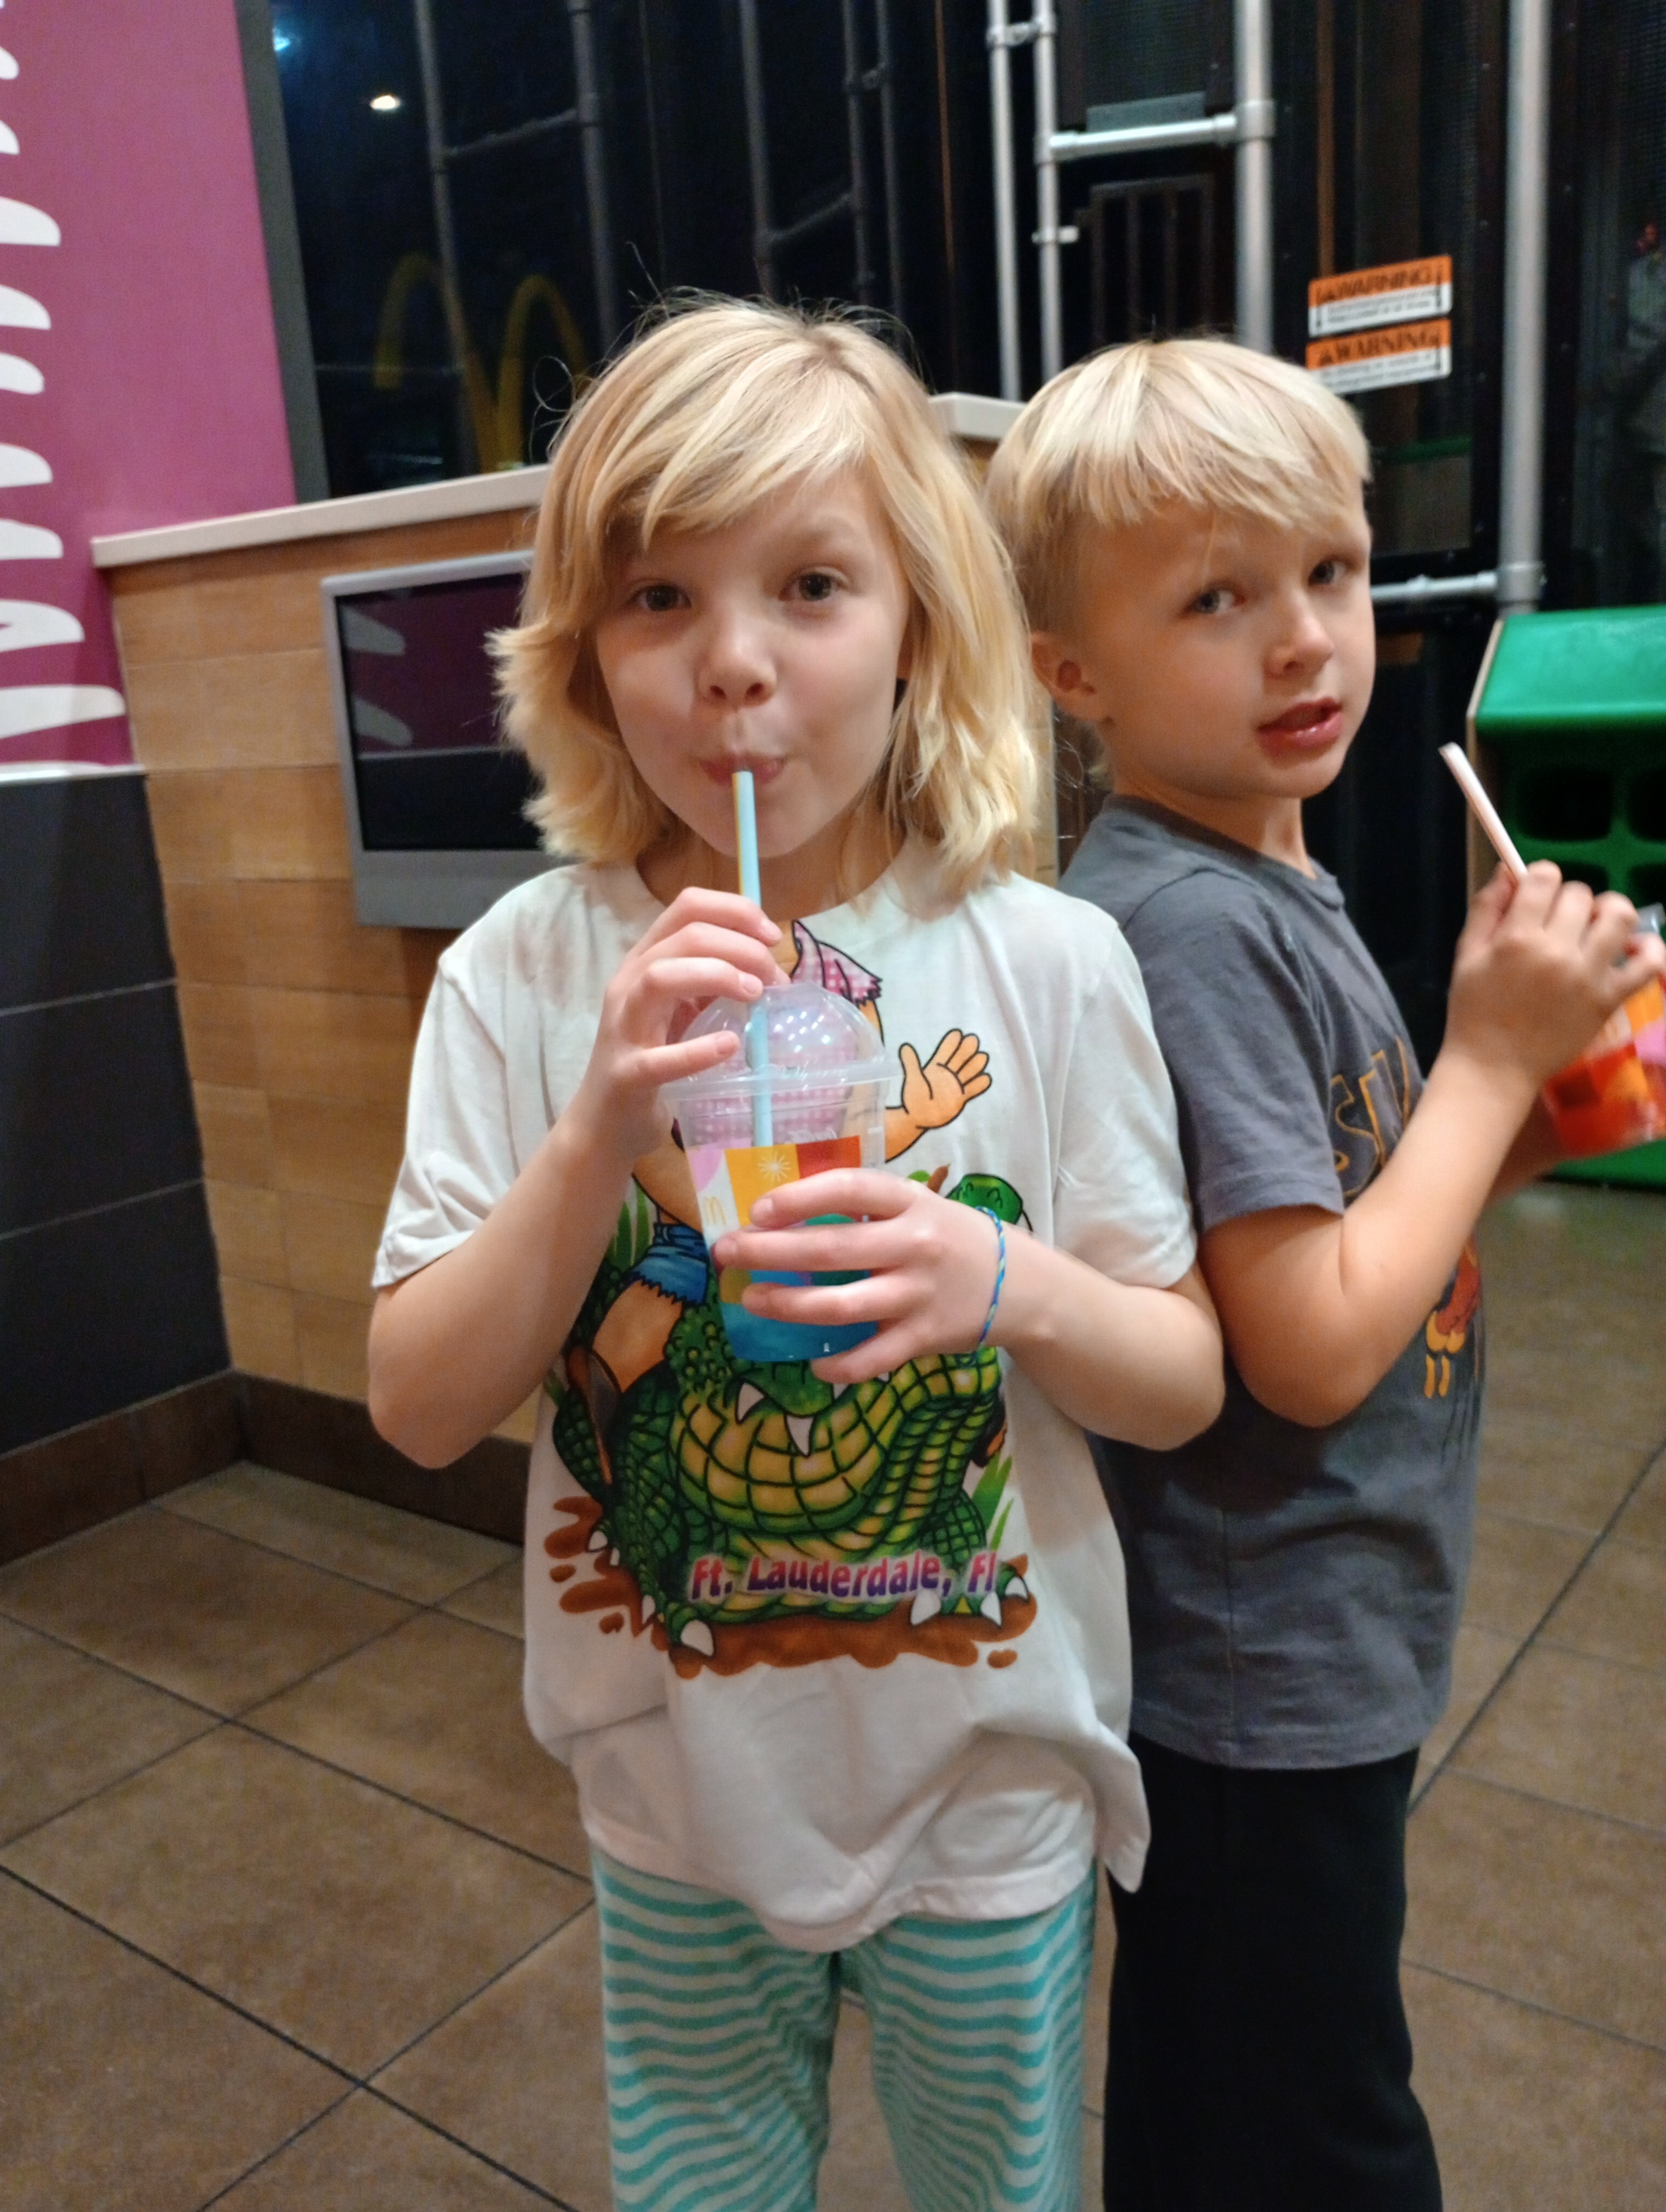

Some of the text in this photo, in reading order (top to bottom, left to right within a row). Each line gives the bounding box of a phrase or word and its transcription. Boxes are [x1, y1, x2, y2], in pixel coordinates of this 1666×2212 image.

[1335, 328, 1440, 364] WARNING
[691, 1558, 733, 1600] Ft.
[747, 1550, 951, 1598] Lauderdale,
